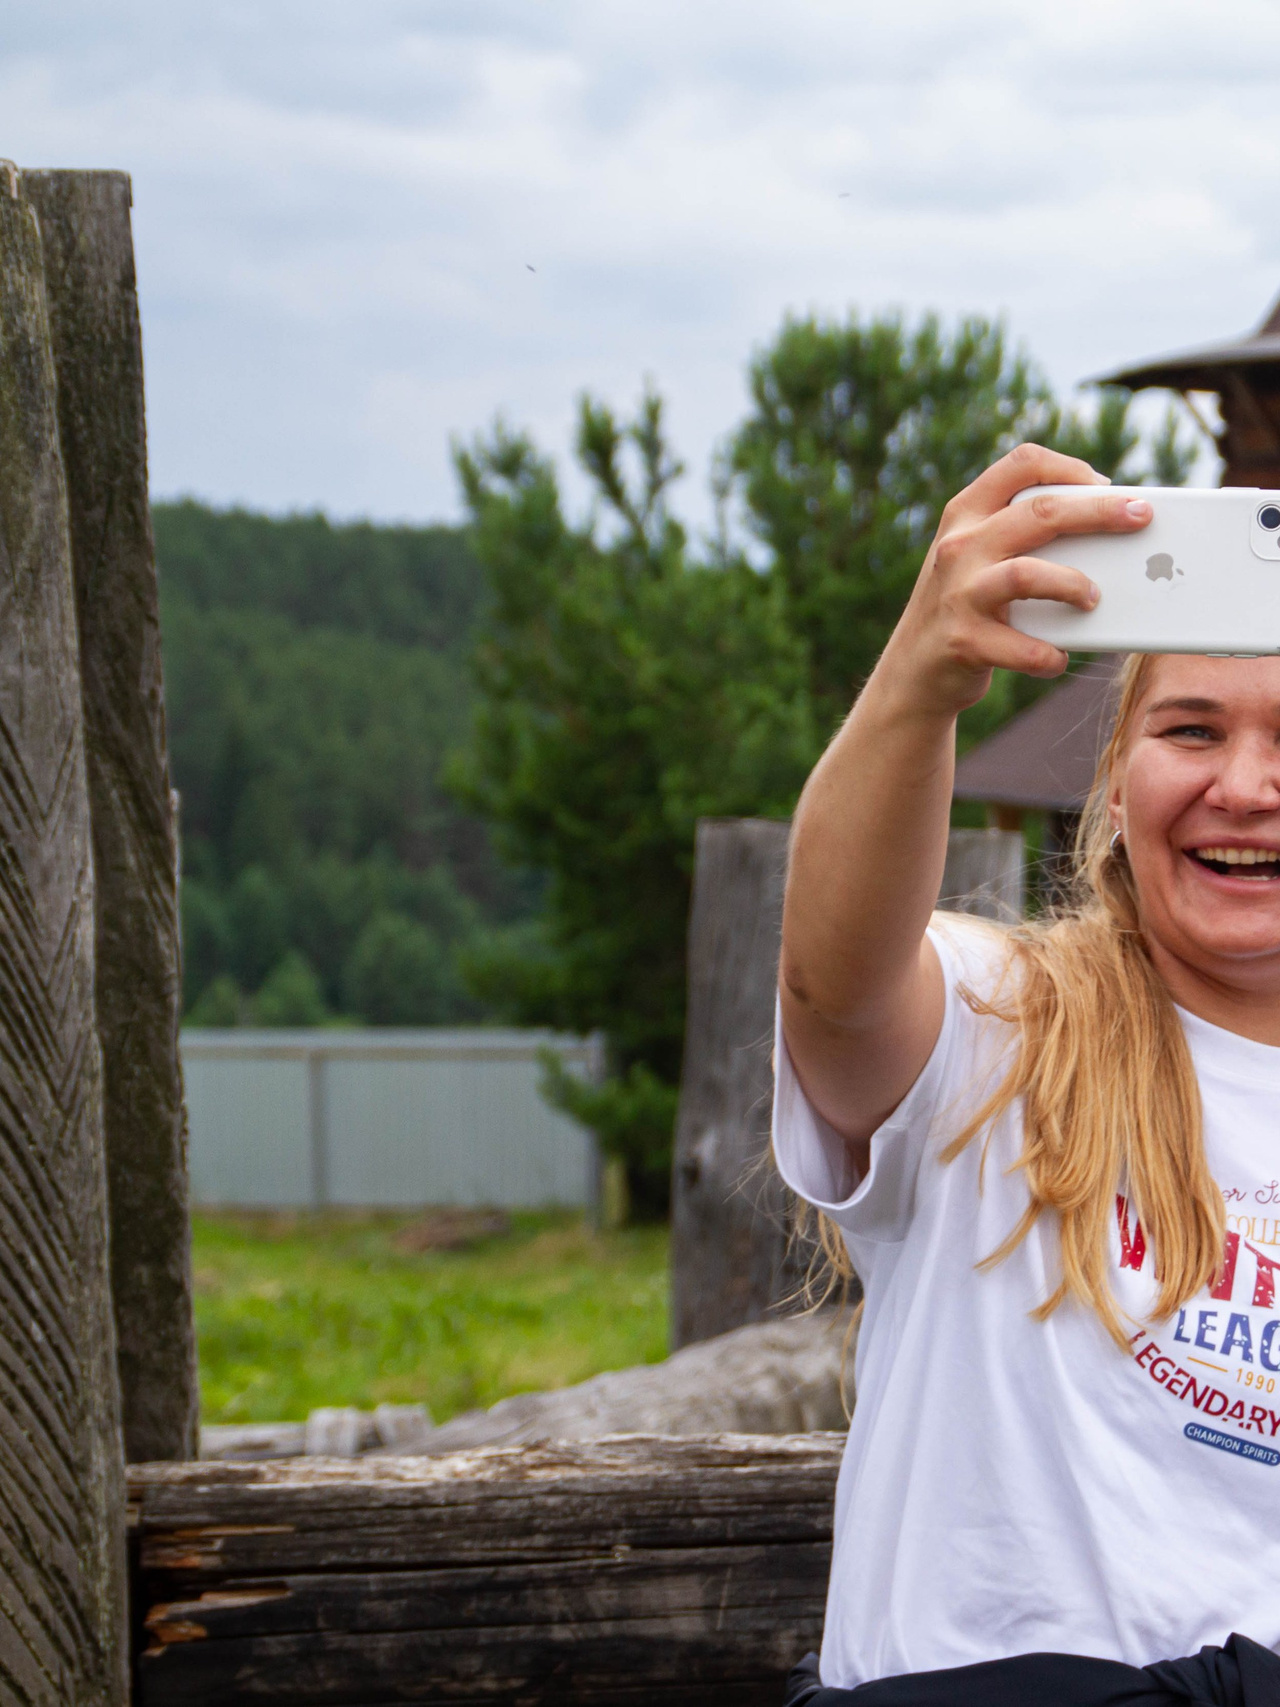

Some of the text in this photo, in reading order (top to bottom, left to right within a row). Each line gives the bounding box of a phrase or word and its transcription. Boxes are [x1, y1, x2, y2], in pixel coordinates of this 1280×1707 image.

[1236, 1368, 1276, 1394] 1990
[1186, 1425, 1279, 1464] CHAMPION SPIRITS
